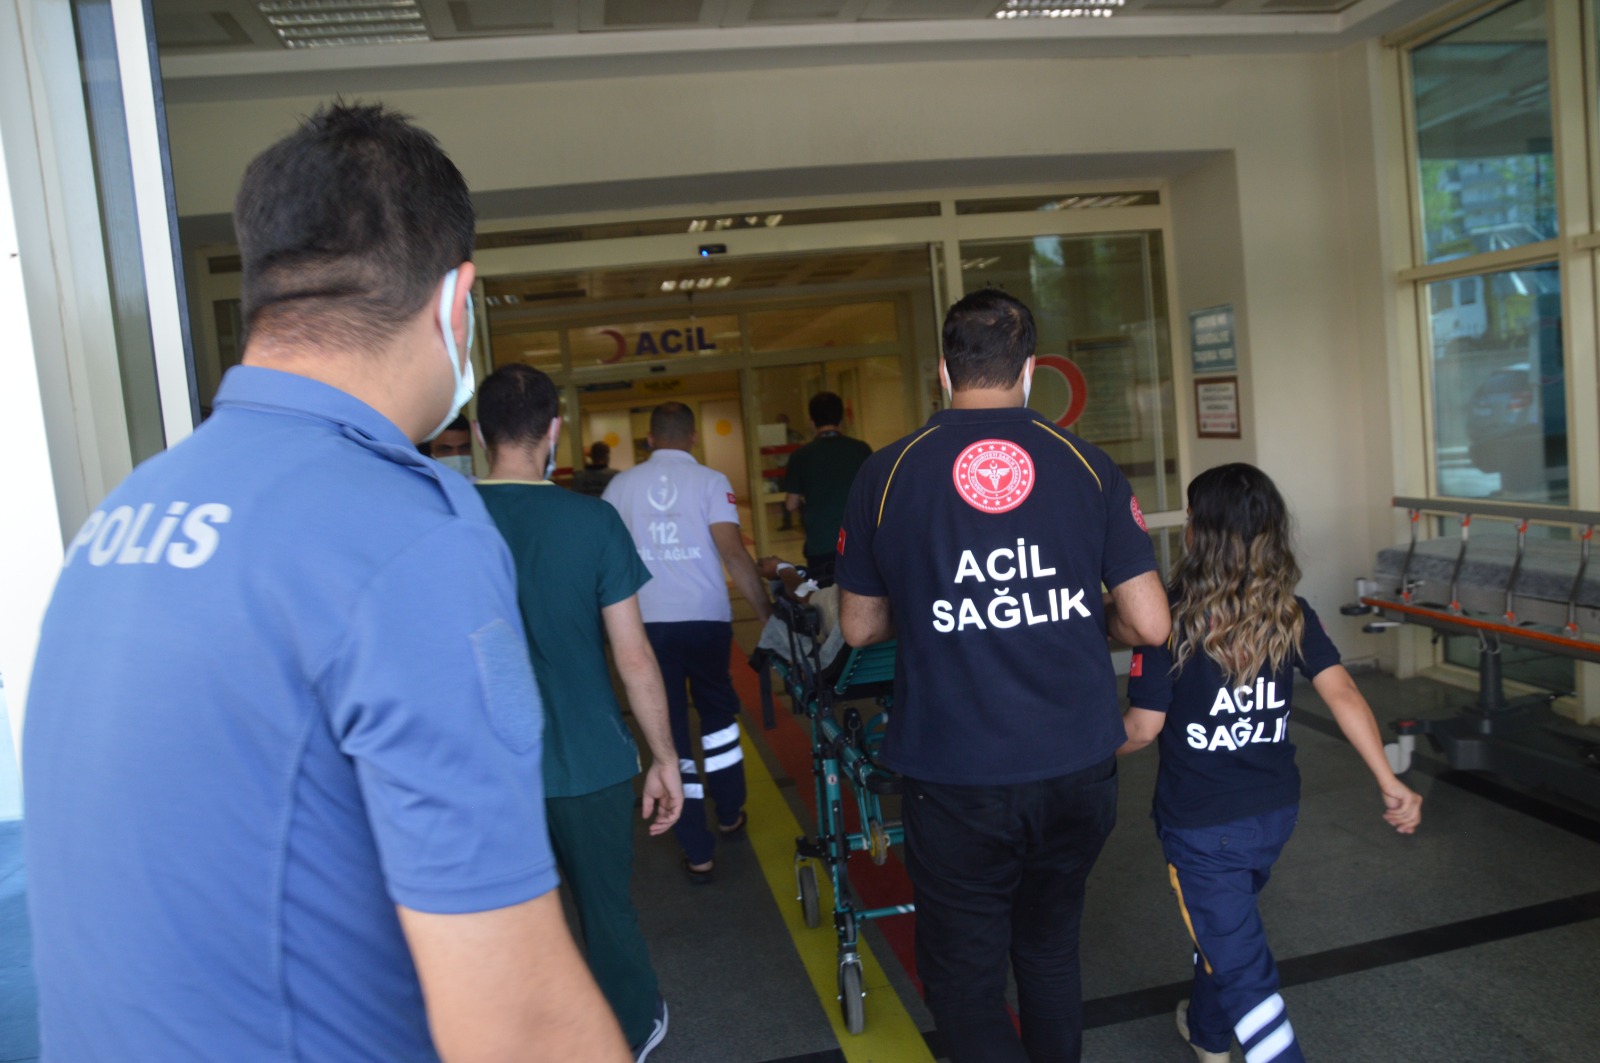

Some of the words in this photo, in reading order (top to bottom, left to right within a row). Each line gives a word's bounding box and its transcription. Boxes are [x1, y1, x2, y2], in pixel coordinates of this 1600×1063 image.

[649, 521, 680, 544] 112
[954, 538, 1056, 583] ACİL
[932, 587, 1091, 633] SAĞLIK
[1209, 677, 1286, 716] ACİL
